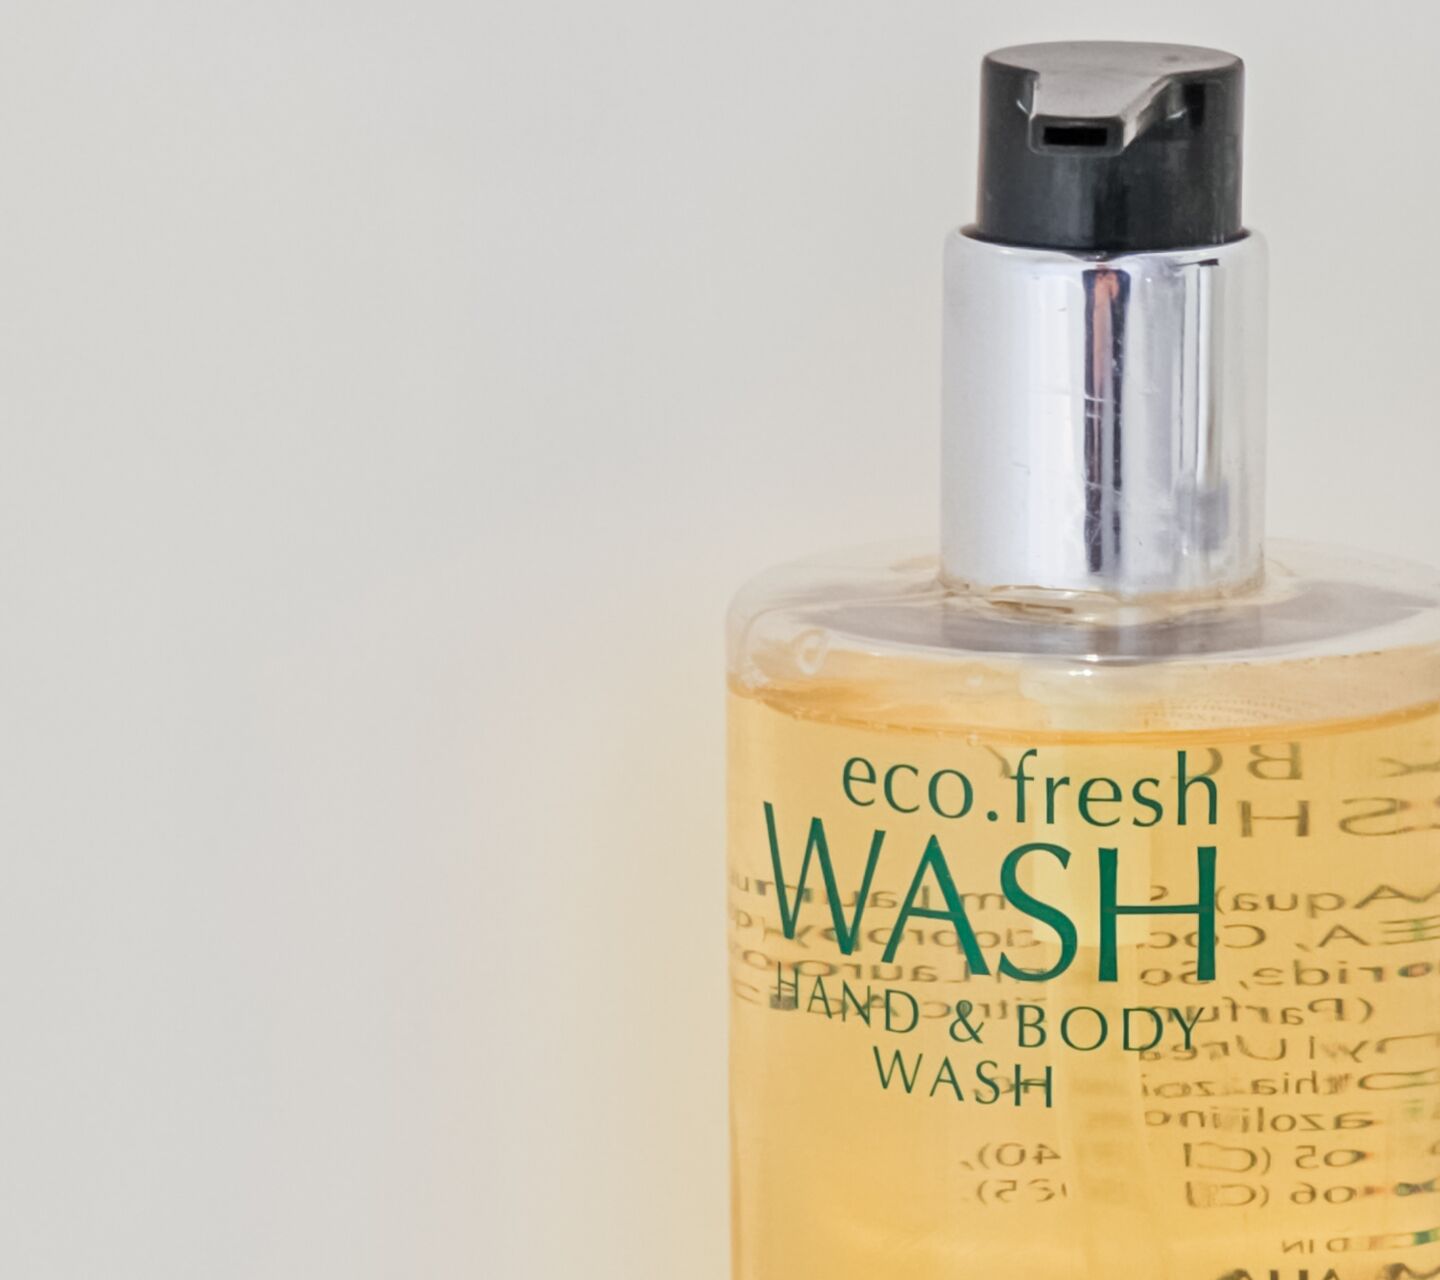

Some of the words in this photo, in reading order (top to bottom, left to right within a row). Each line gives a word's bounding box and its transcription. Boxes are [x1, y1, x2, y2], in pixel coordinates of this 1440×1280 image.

[841, 748, 1219, 828] eco.fresh
[762, 800, 1218, 984] WASH
[776, 960, 921, 1035] HAND
[948, 999, 985, 1045] &
[1016, 1003, 1206, 1053] BODY
[872, 1045, 1054, 1109] WASH
